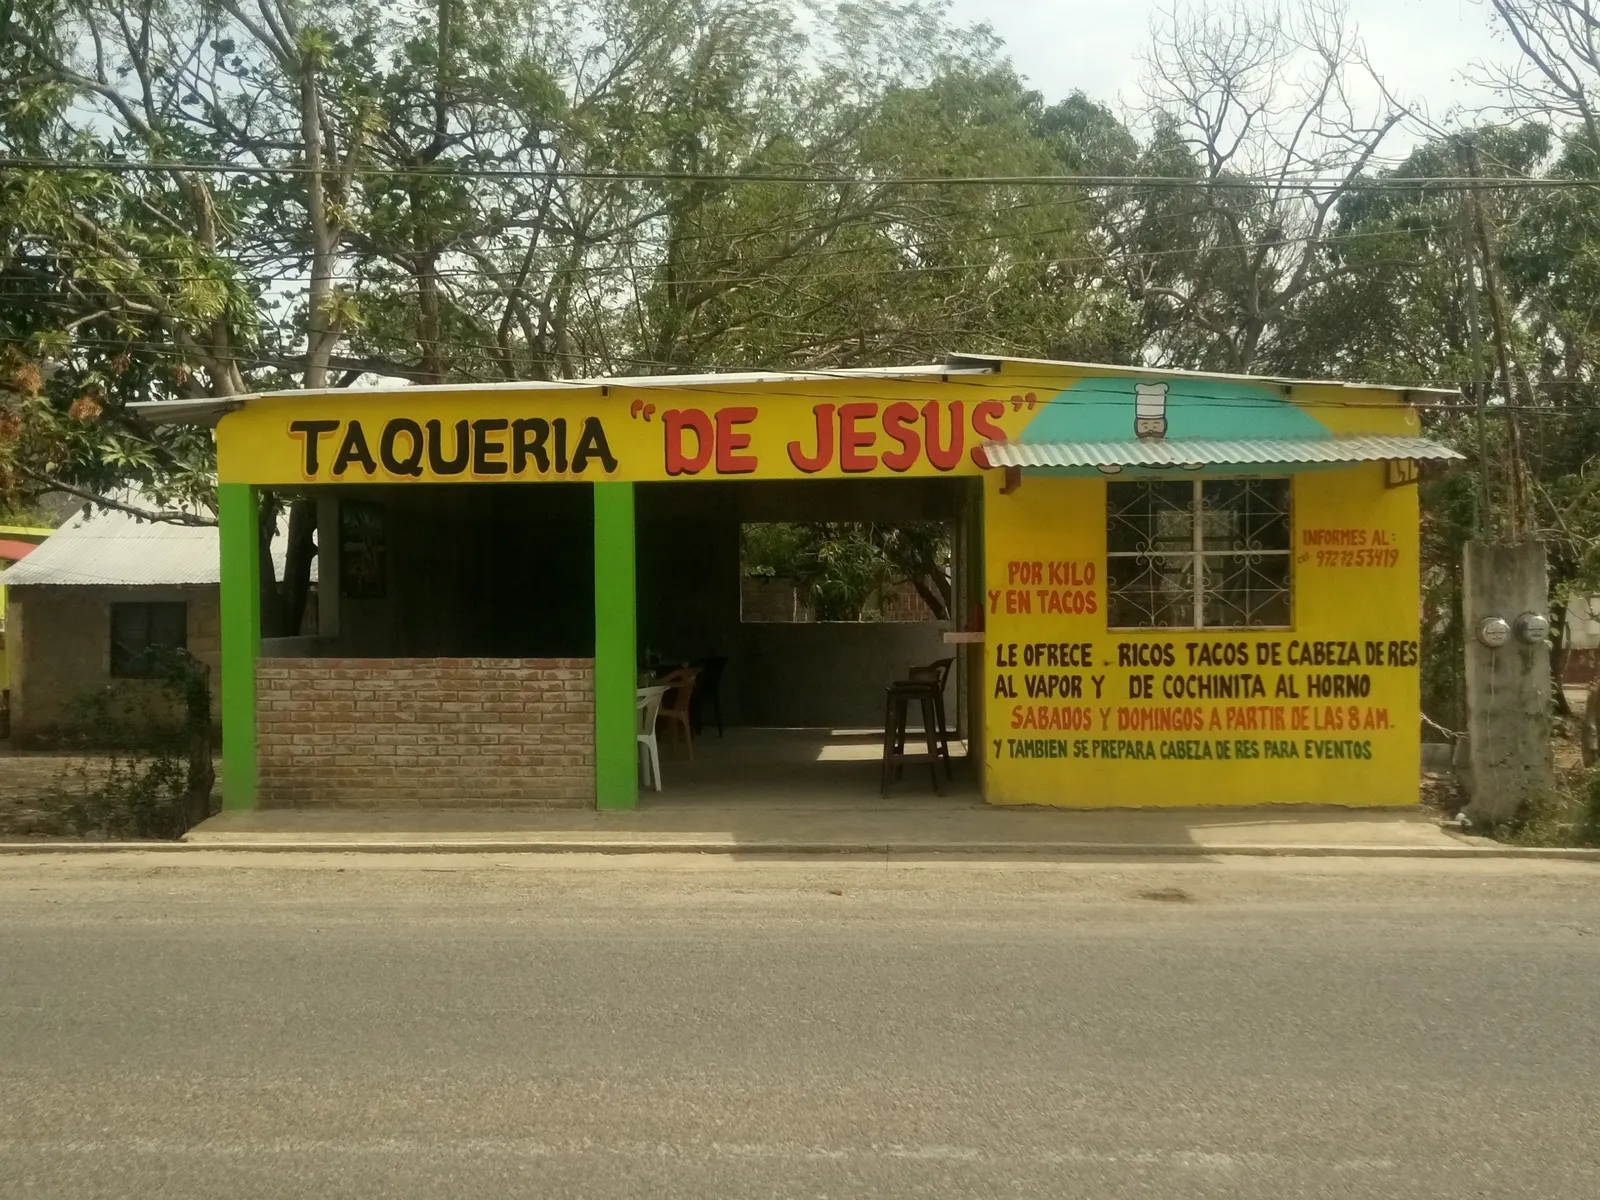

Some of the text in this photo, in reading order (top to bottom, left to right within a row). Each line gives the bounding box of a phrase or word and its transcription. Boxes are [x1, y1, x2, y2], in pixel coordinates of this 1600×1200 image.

[288, 416, 620, 479] TAQUERIA
[1303, 529, 1367, 546] INFORMES
[1008, 560, 1096, 586] POR KILO
[988, 589, 1098, 615] Y EN TACOS
[996, 640, 1418, 667] LE OFRECE RICOS TACOS DE CABEZA DE RES
[994, 674, 1371, 699] AL VAPOR Y DE COCHINITA AL HORNO
[1010, 705, 1092, 731] SABADOS
[1099, 706, 1111, 731] Y
[1117, 706, 1203, 731] DOMINGOS
[1208, 707, 1222, 731] A
[1226, 705, 1286, 731] PARTIR
[1291, 705, 1310, 731] DE
[1314, 705, 1343, 731] LAS
[1348, 706, 1360, 731] 8
[993, 738, 1372, 760] Y TAMBIEN SE PREPARA CABEZA DE RES PARA EVENTOS
